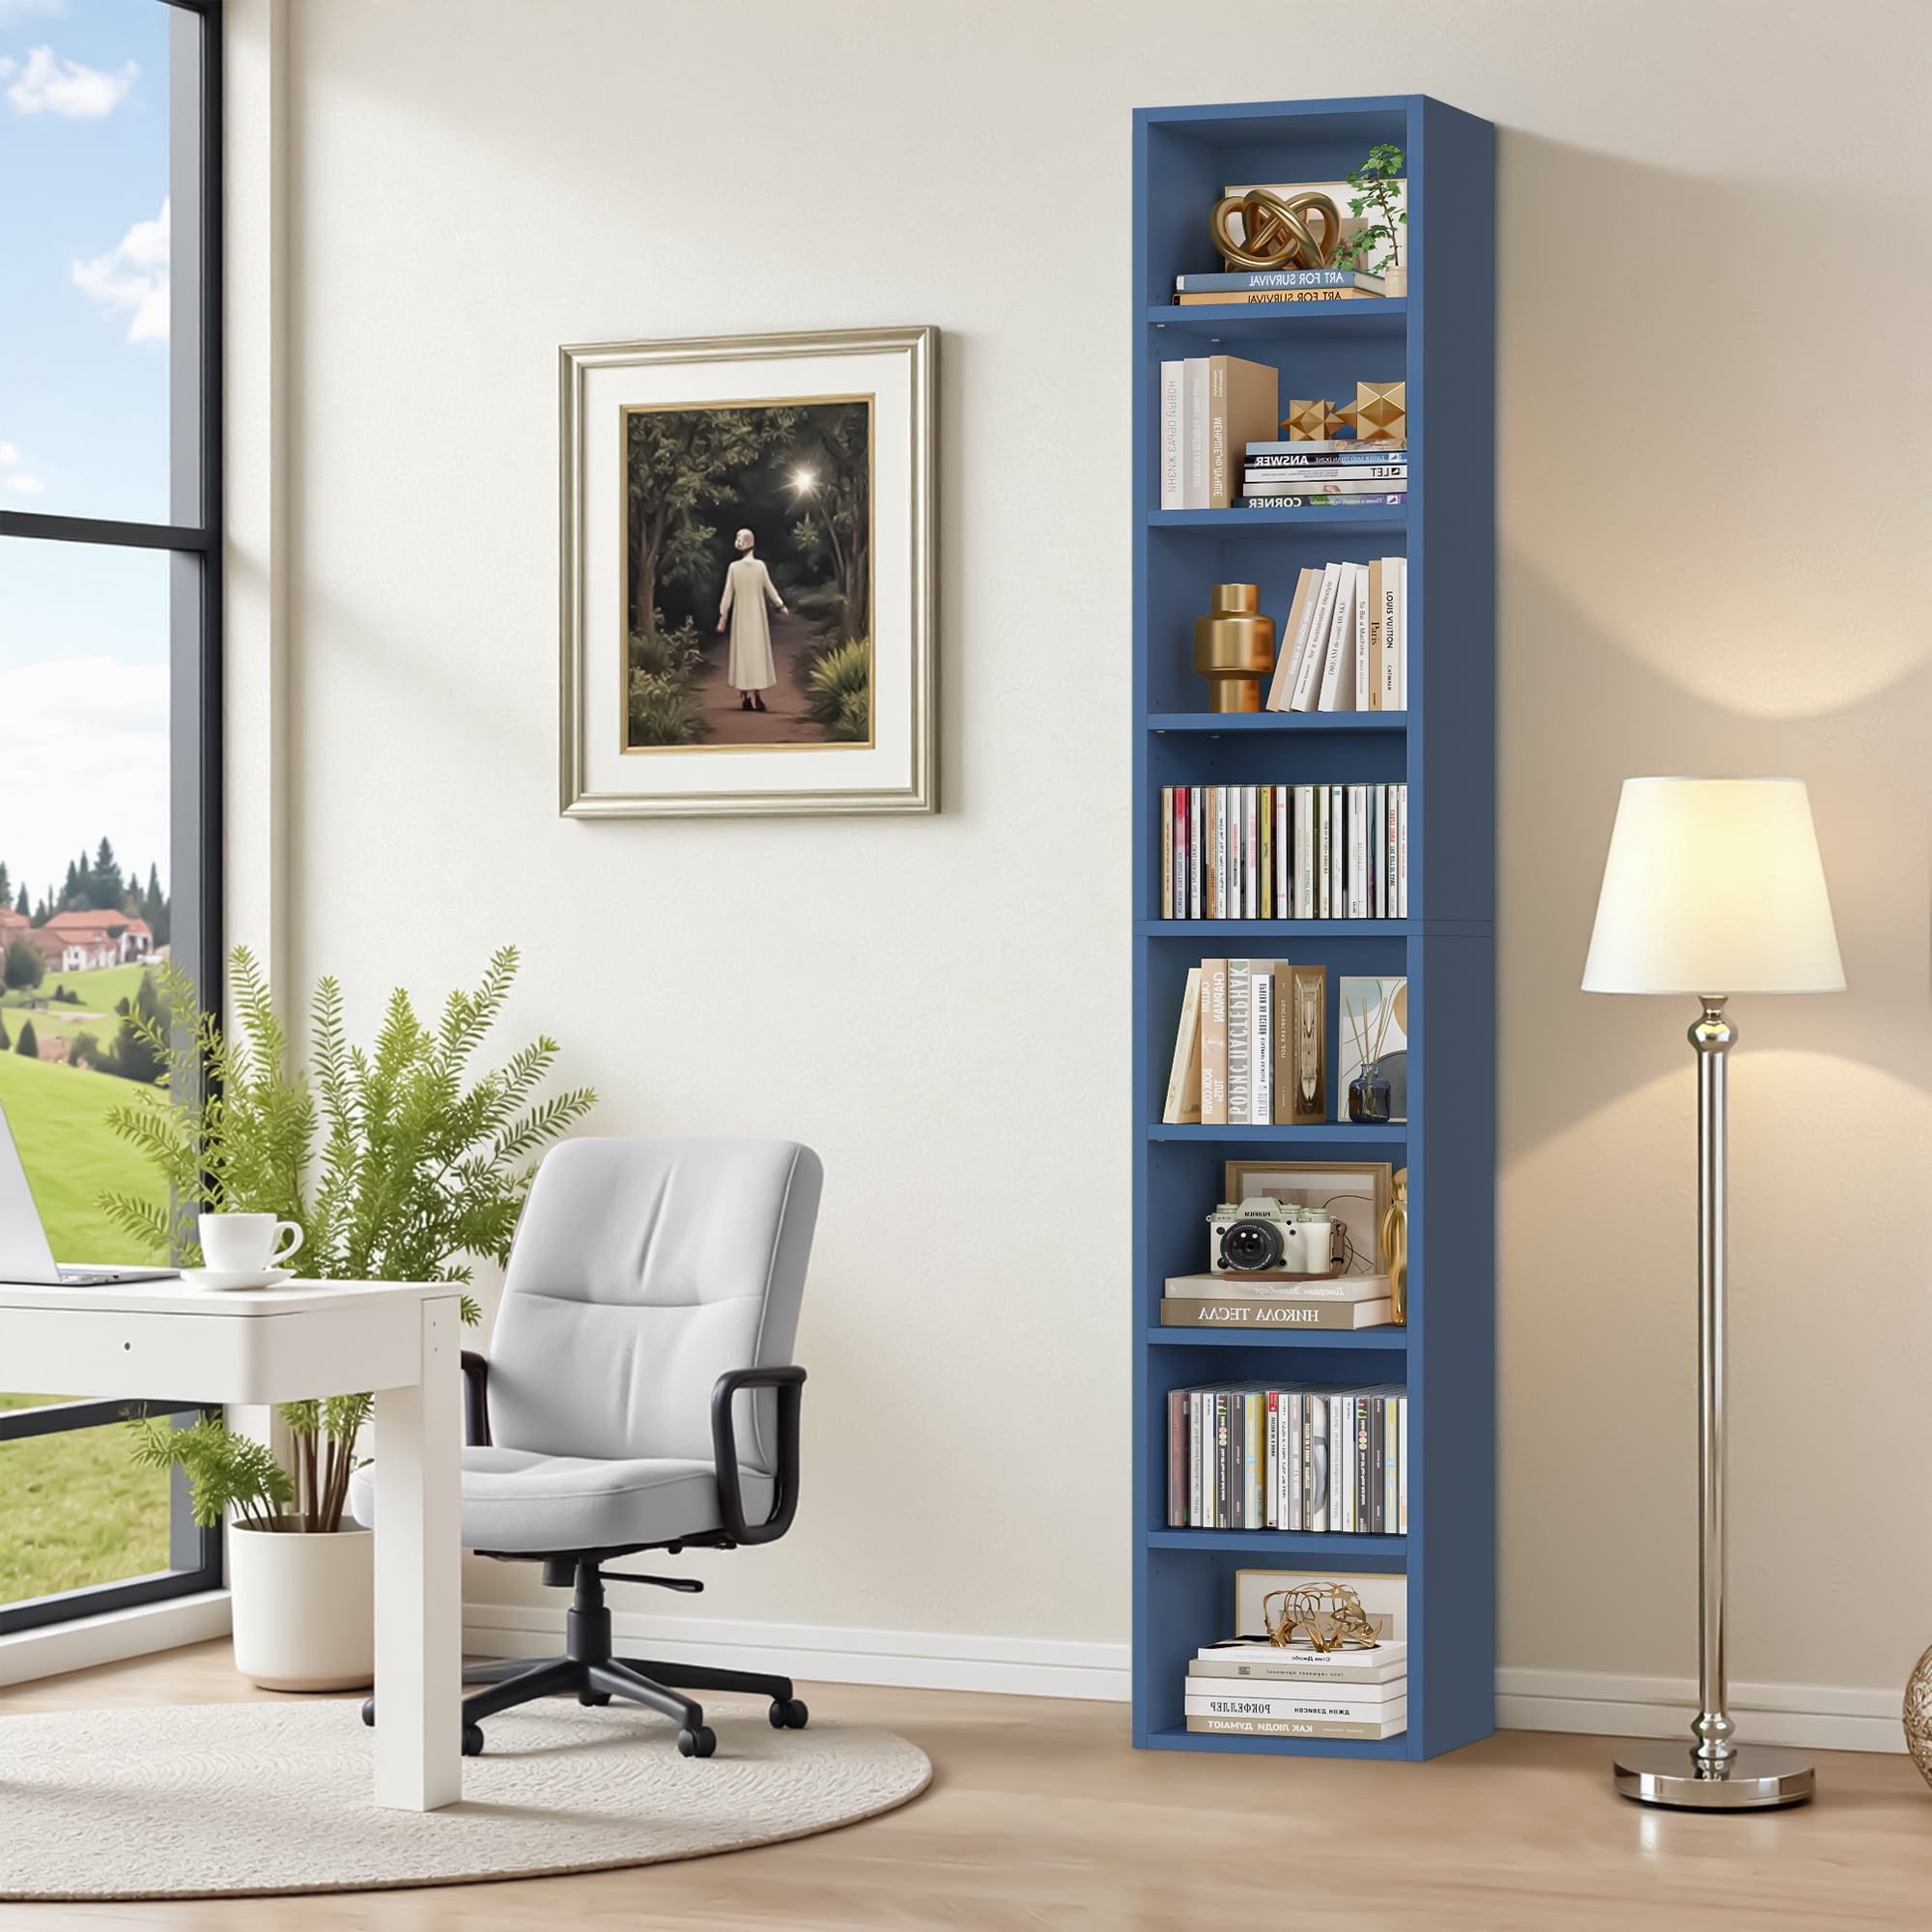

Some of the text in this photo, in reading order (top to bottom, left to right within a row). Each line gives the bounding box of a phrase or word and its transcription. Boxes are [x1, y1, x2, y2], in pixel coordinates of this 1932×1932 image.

[1312, 607, 1325, 642] sustainable
[1319, 581, 1332, 606] lifestyle
[1372, 622, 1380, 645] Paris
[1328, 649, 1338, 675] DREAM
